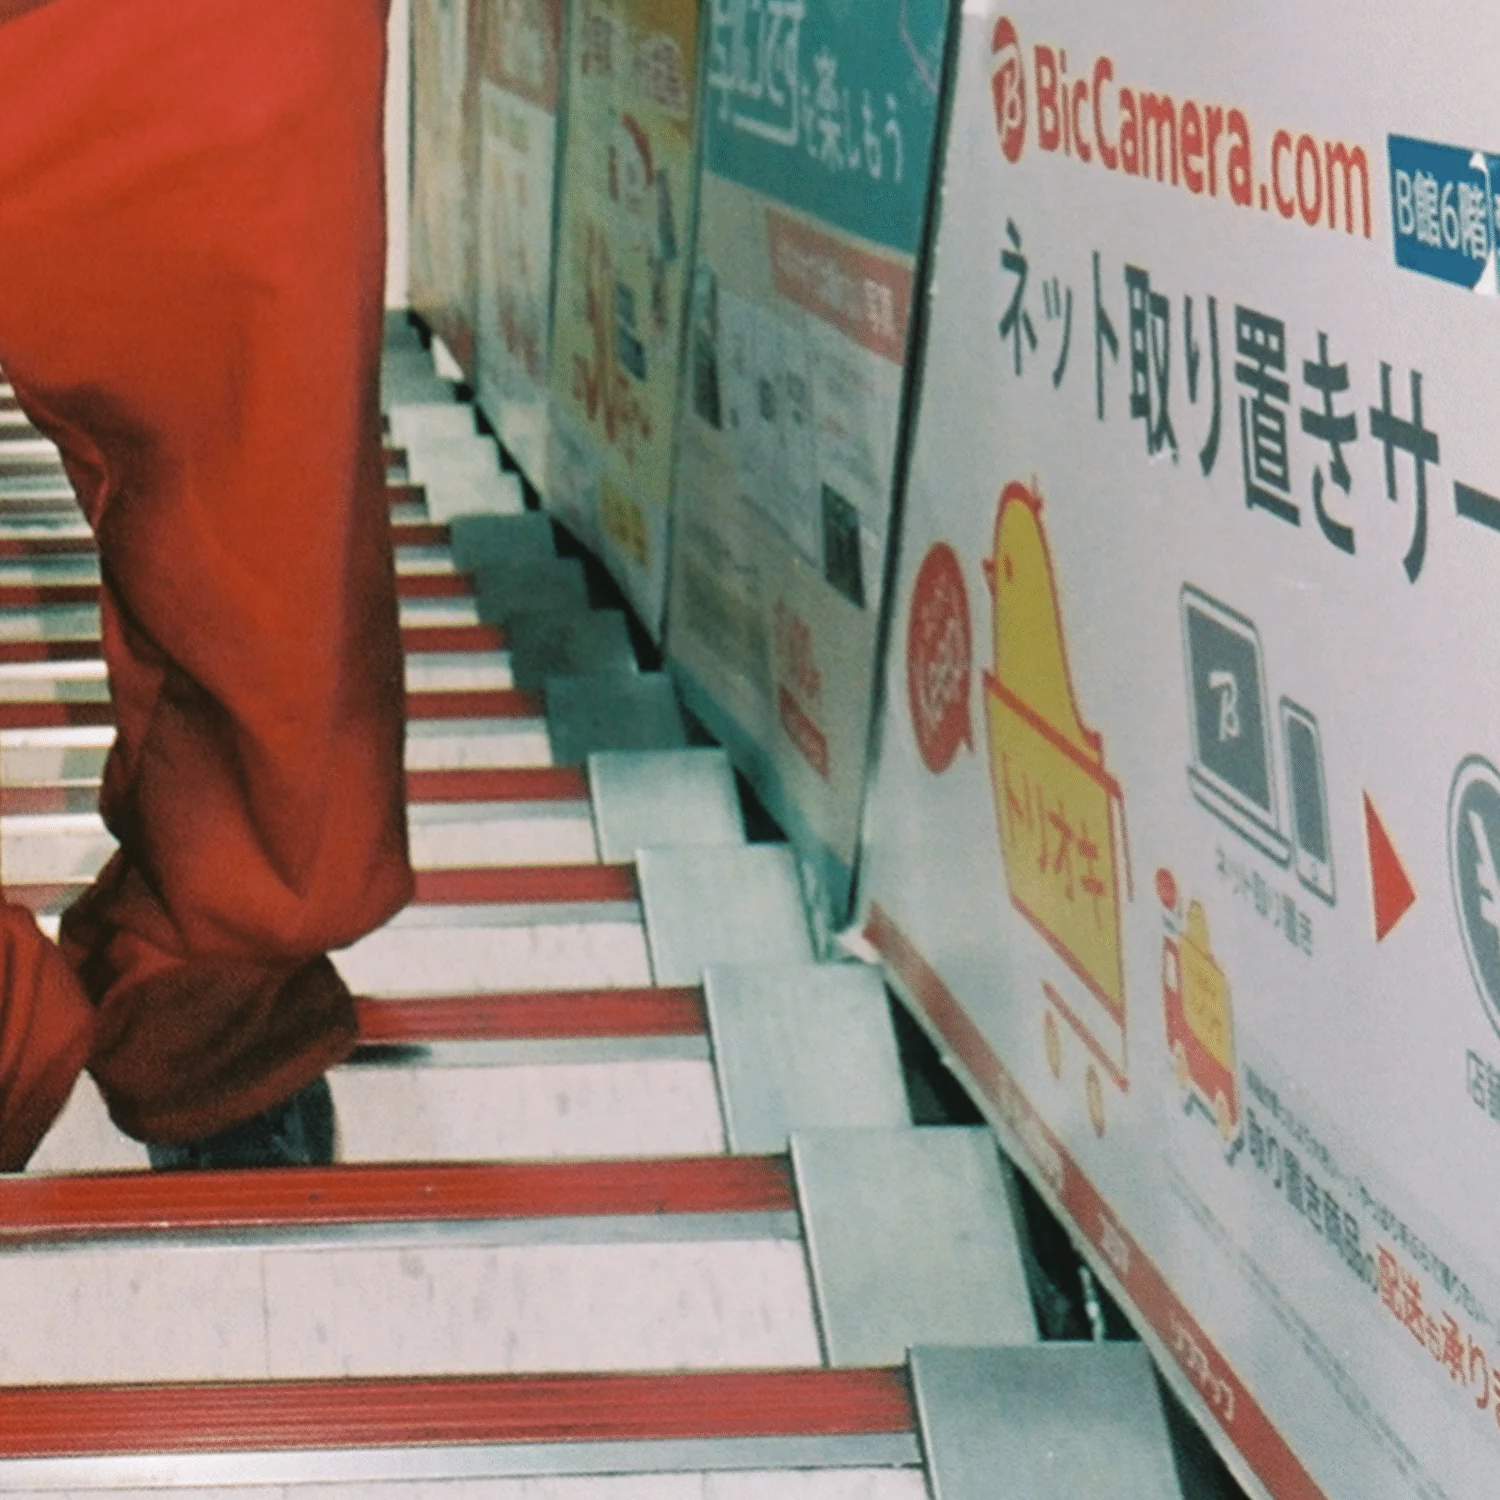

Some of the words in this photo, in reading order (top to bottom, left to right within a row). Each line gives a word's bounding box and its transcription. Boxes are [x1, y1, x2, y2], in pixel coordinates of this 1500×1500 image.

[1033, 44, 1372, 239] BicCamera.com
[998, 216, 1500, 584] ネット取り置きサー
[1002, 749, 1107, 931] トリオキ
